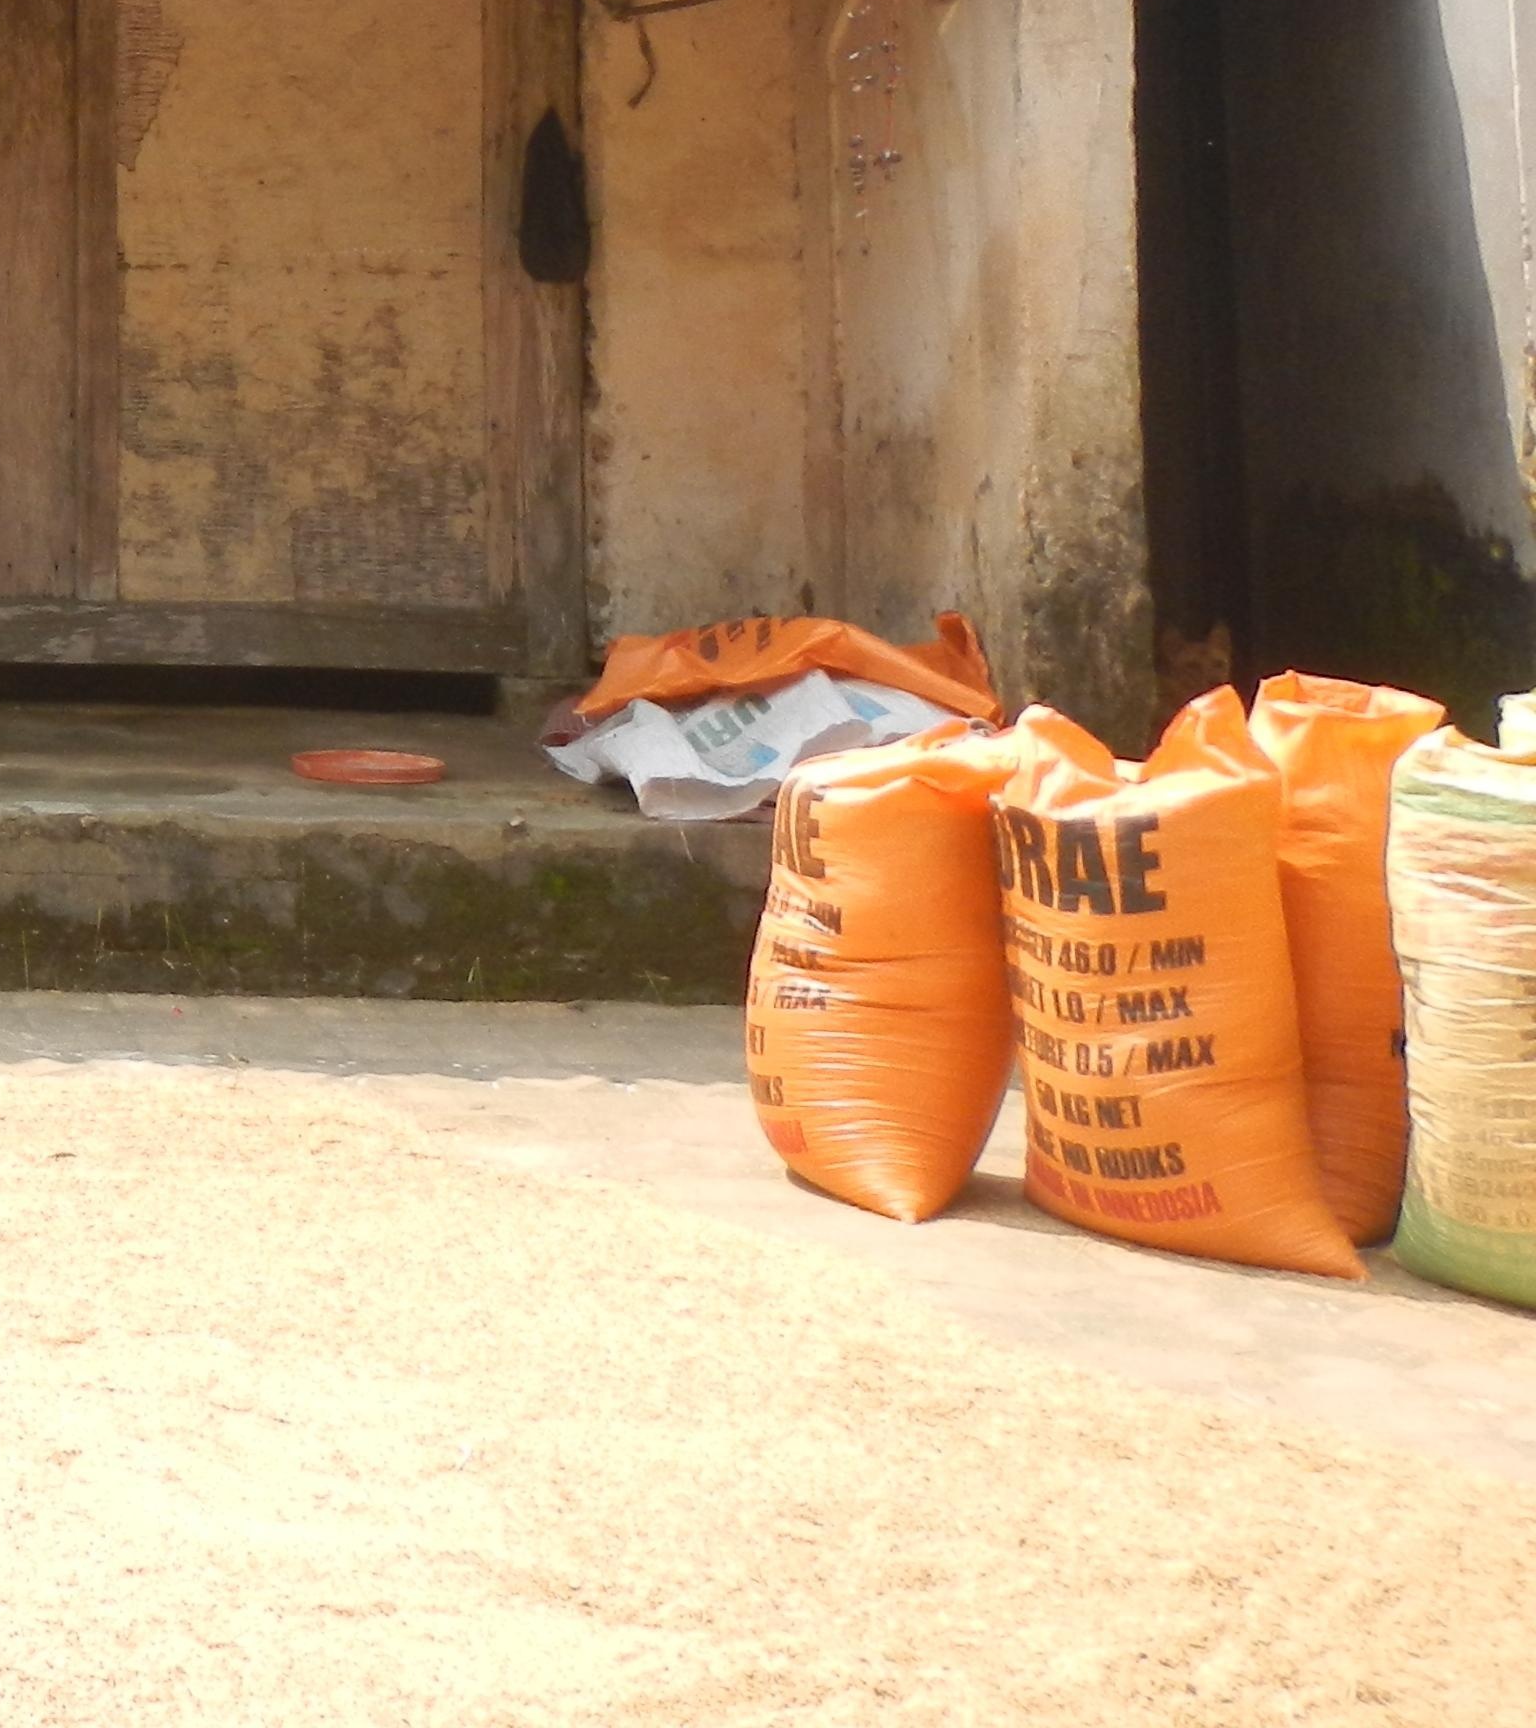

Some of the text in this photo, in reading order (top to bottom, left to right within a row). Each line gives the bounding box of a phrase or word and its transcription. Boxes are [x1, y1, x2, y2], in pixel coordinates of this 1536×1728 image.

[1058, 938, 1117, 977] 46.0
[1149, 936, 1205, 971] MIN
[1116, 986, 1194, 1024] MAX
[1075, 1040, 1115, 1078] 0.5
[1146, 1034, 1216, 1075] MAX
[1094, 1094, 1143, 1130] NET
[1095, 1141, 1186, 1181] HOOKS
